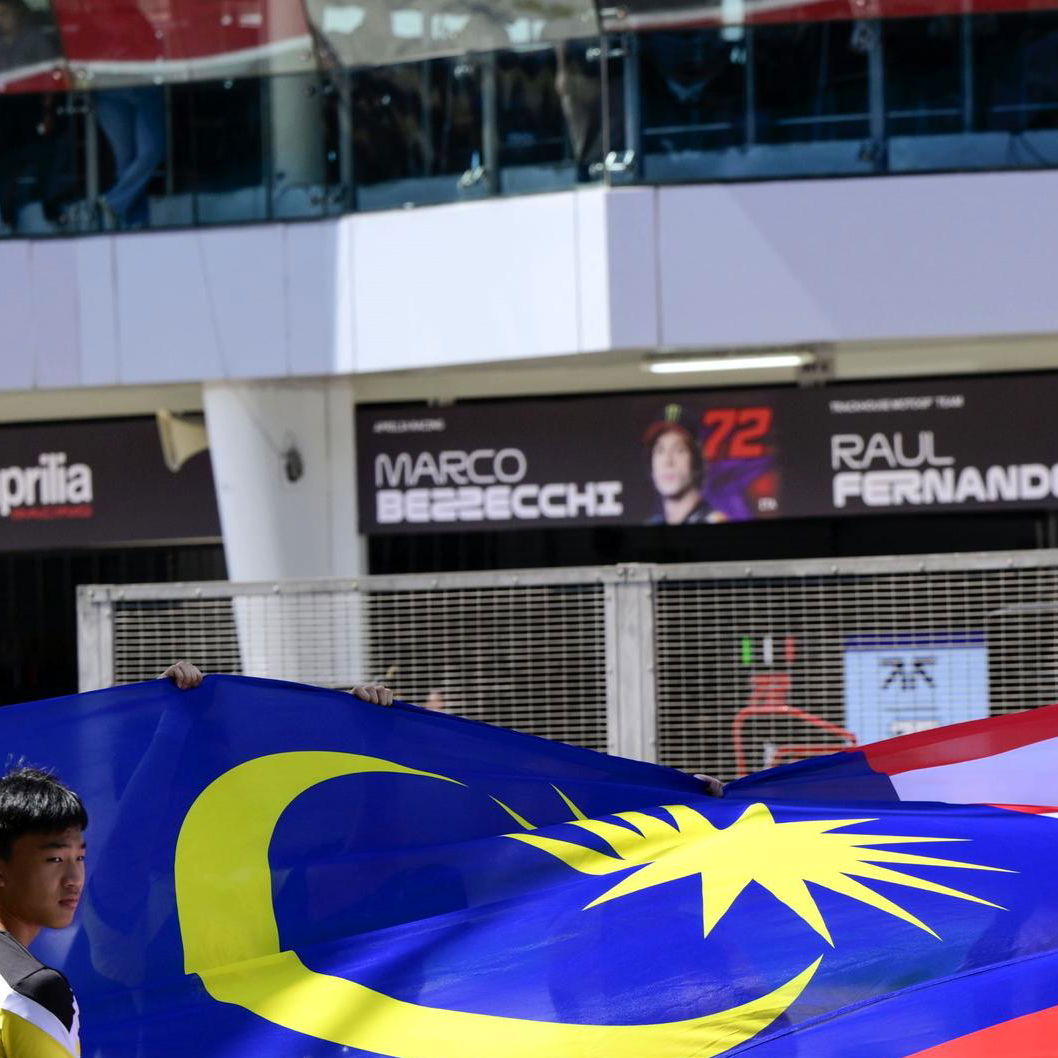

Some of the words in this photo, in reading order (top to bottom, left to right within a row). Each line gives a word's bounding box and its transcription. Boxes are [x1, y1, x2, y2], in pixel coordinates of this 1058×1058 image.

[703, 407, 772, 460] 72
[831, 431, 955, 469] RAUL
[375, 448, 527, 487] MARCO
[377, 481, 623, 524] BEZZECCHI
